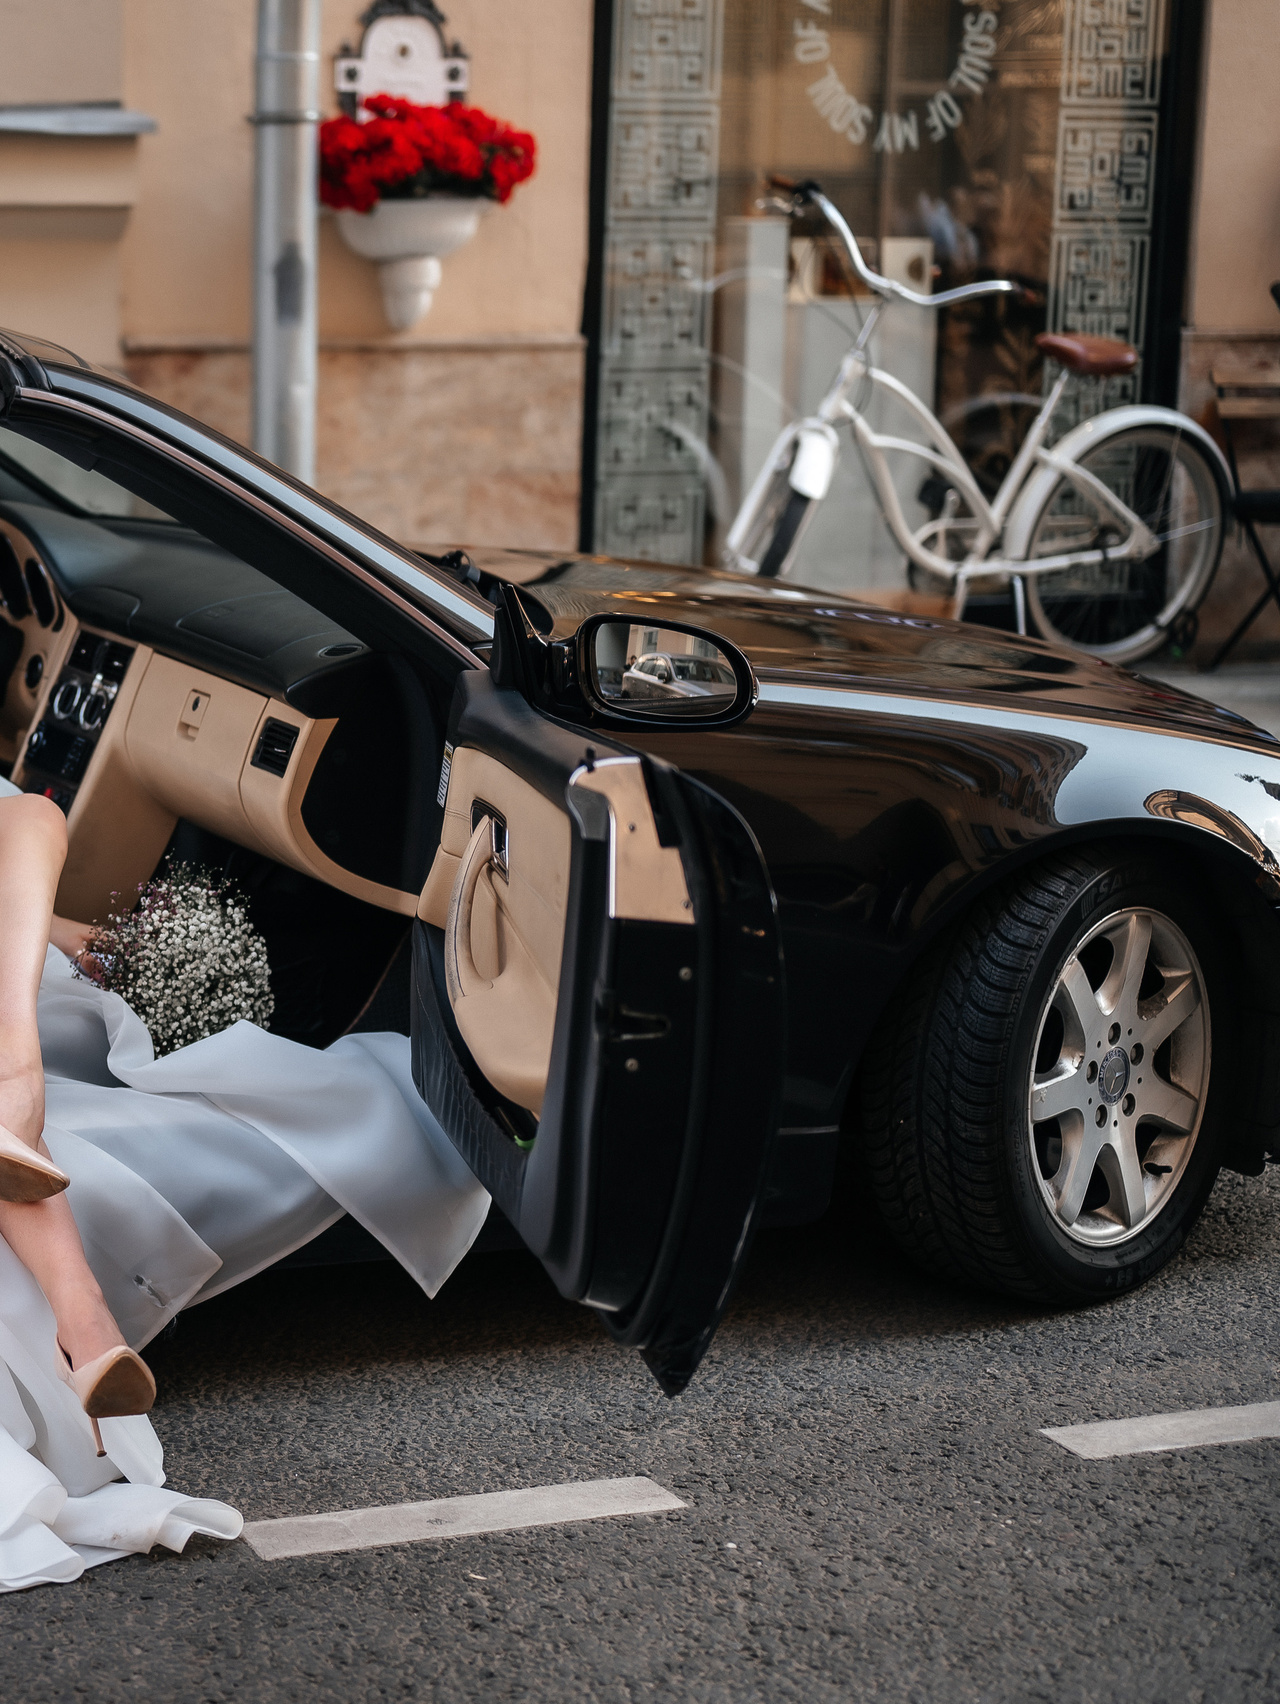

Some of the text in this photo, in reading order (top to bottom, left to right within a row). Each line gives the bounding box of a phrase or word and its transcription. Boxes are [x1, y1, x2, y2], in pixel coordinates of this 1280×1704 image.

[793, 11, 998, 154] SOUL OF MY SOUL OF
